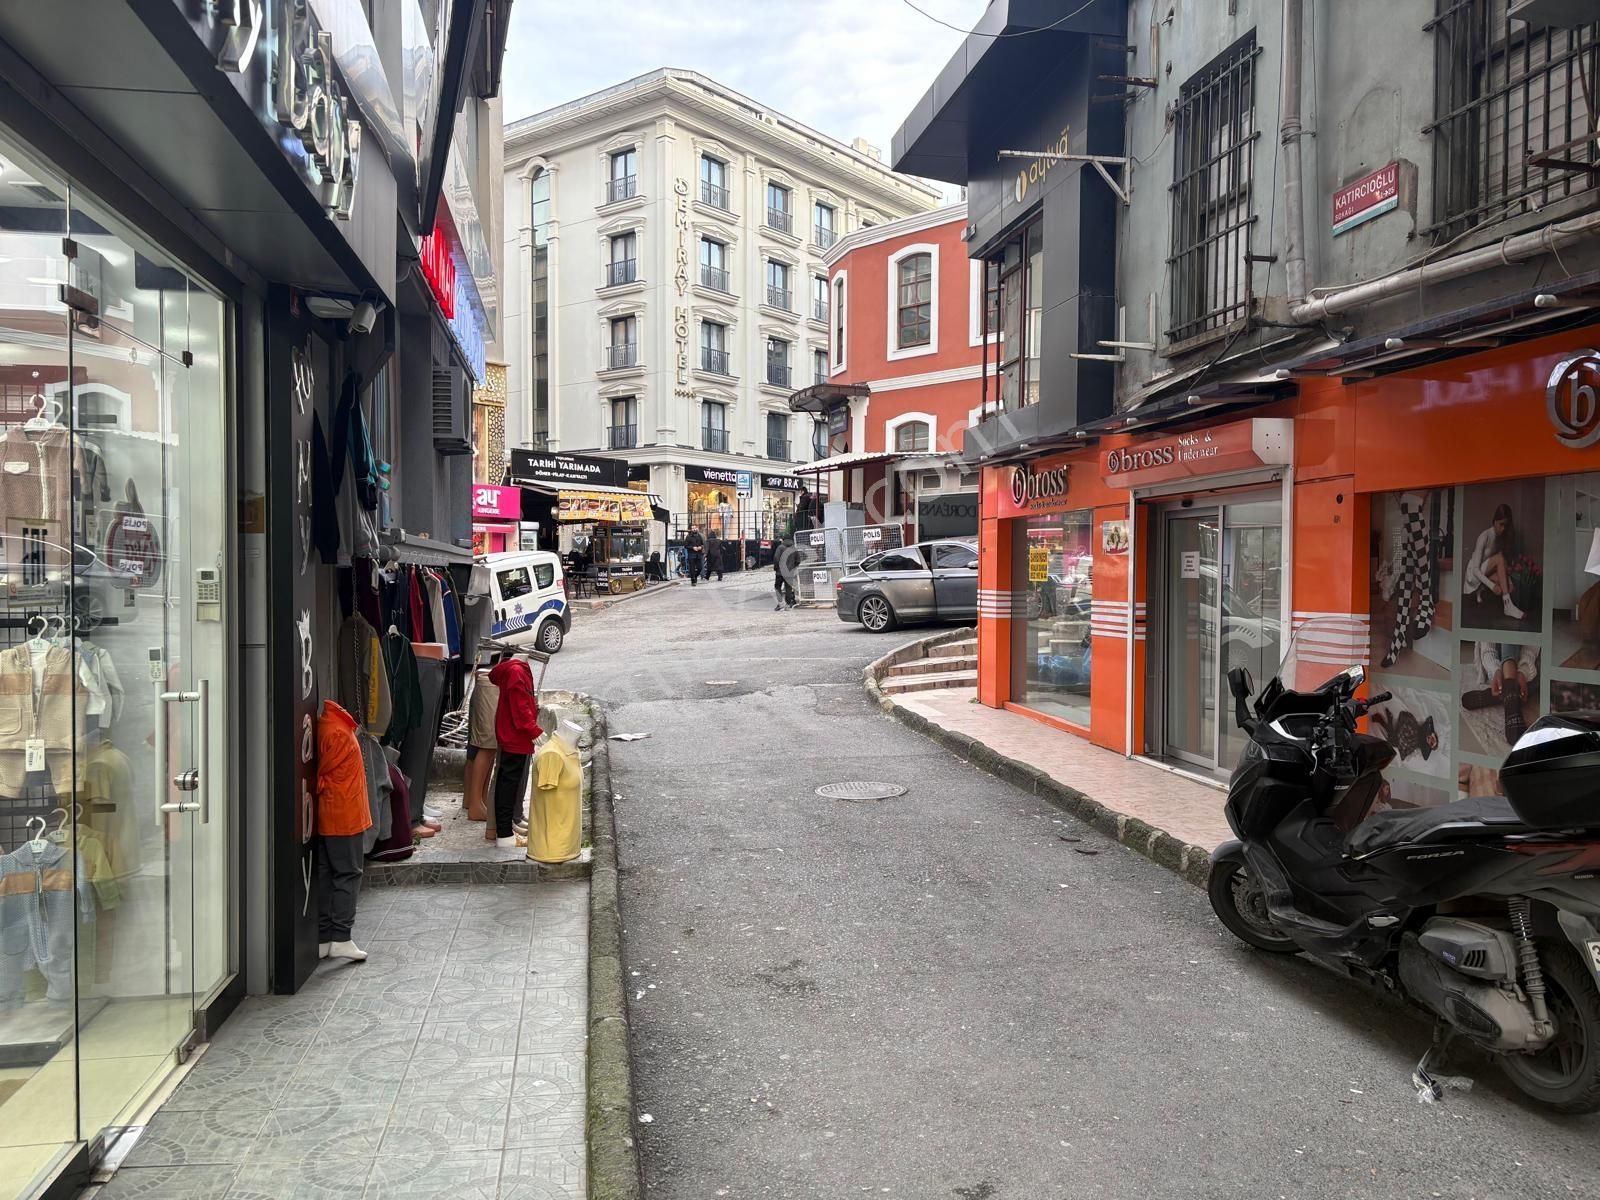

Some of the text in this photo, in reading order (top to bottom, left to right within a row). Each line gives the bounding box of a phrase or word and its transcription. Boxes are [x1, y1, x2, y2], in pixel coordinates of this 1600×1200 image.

[1335, 168, 1395, 210] KATIRCIOĞLU
[674, 306, 689, 384] HOTEL
[527, 458, 557, 469] TARİHİ
[558, 462, 601, 474] YARIMADA
[1122, 447, 1174, 471] bross
[703, 468, 737, 483] vienetta
[1027, 465, 1065, 499] bross
[810, 534, 825, 543] POLİS
[863, 529, 881, 539] POLİS
[813, 571, 827, 580] POLİS
[1406, 850, 1465, 860] FORZA
